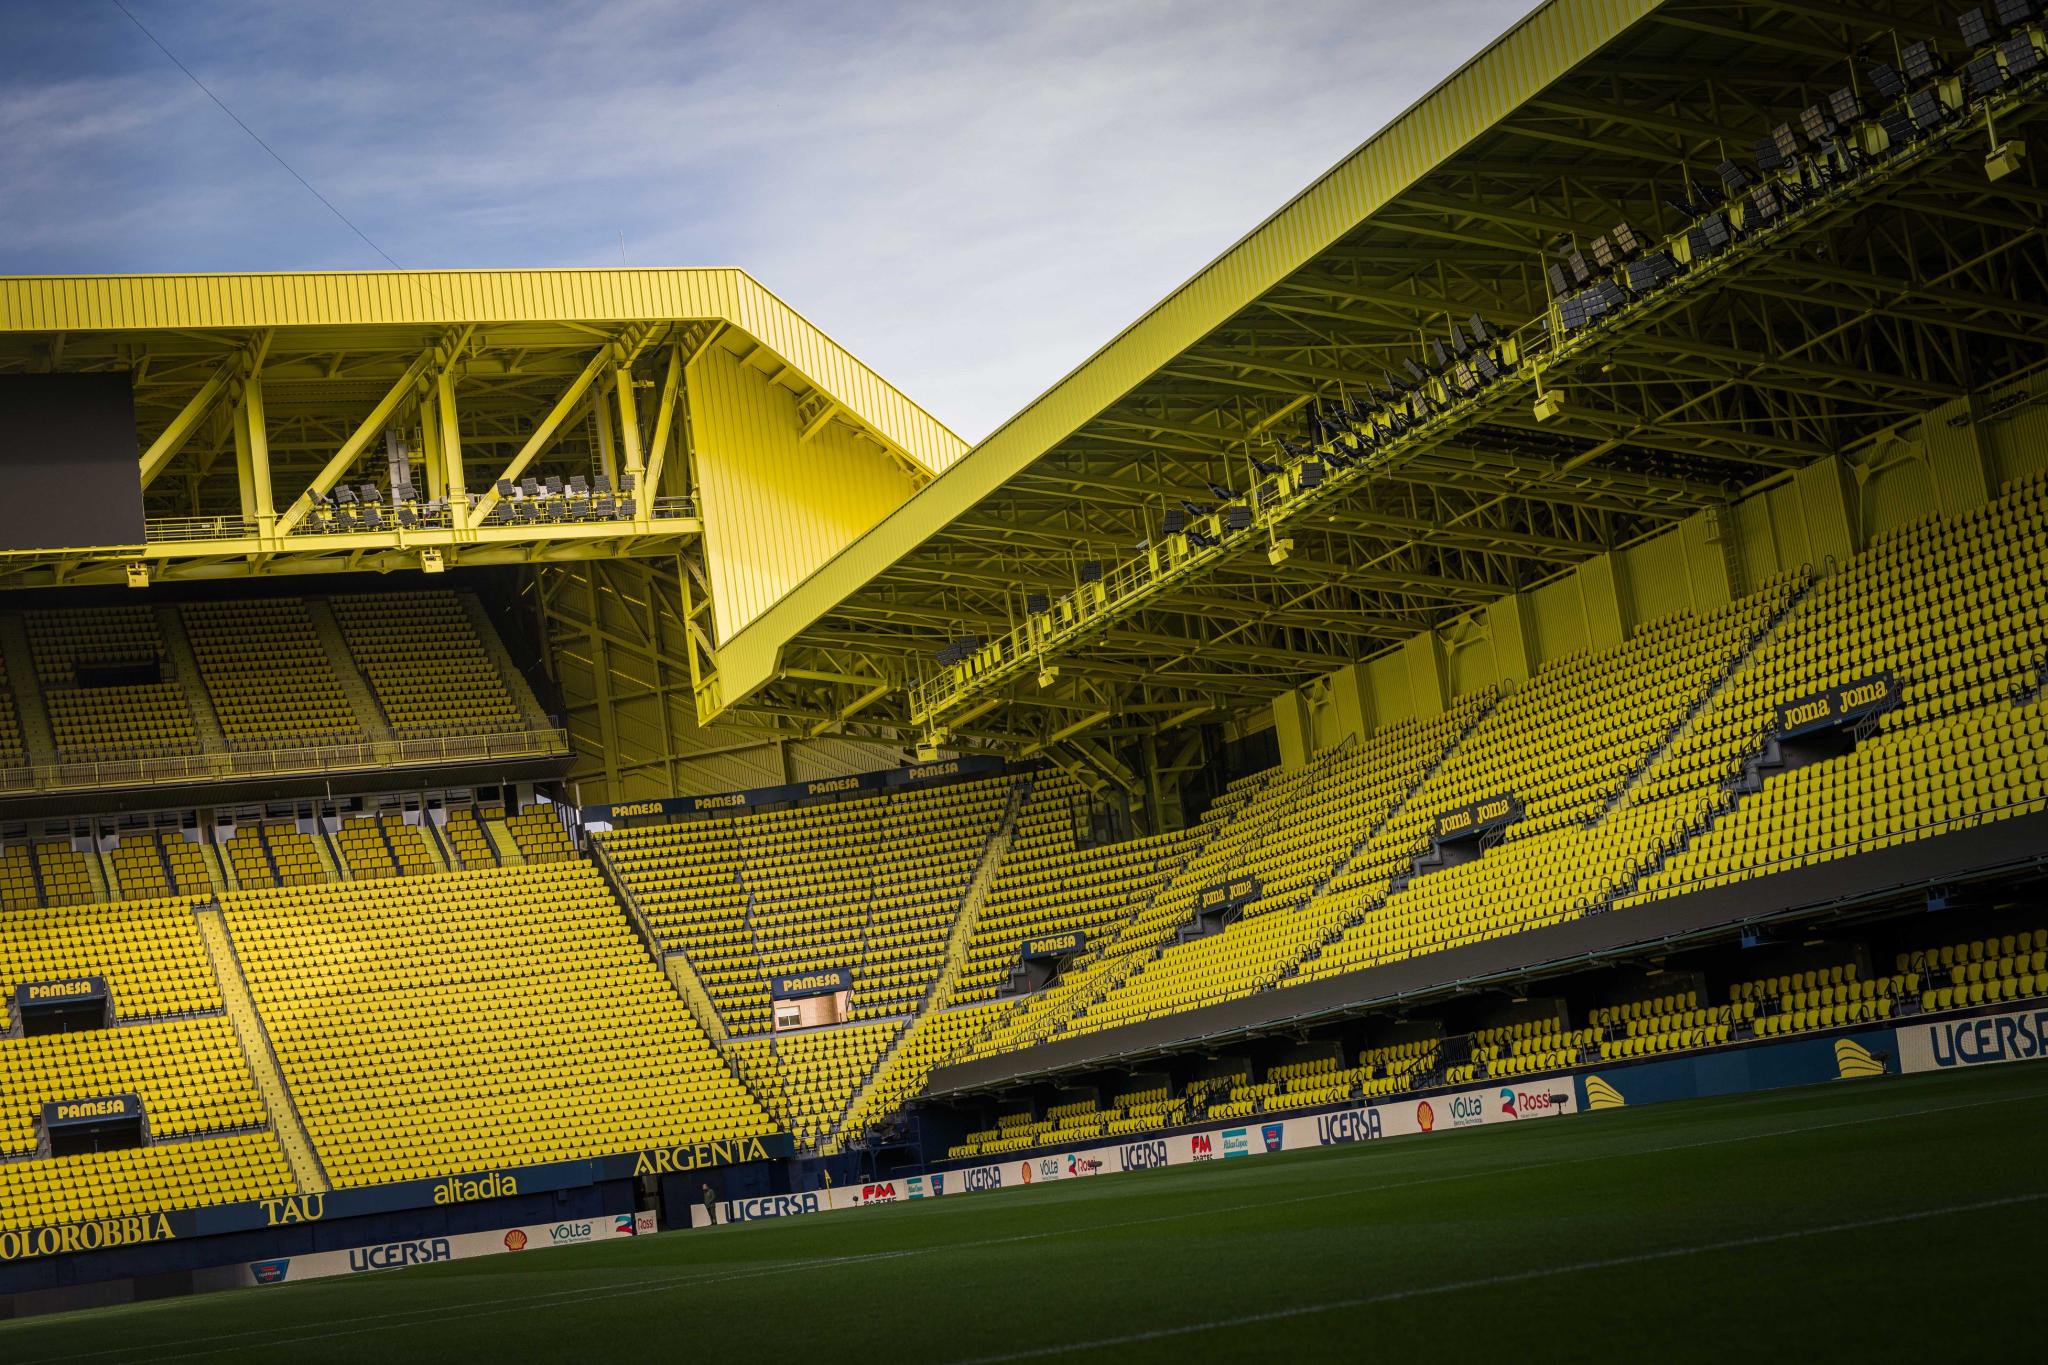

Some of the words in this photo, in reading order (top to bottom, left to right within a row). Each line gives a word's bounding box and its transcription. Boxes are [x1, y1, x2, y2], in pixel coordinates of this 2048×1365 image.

[908, 762, 960, 779] PAMESA
[807, 778, 860, 795] PAMESA
[611, 803, 663, 817] PAMESA
[694, 795, 746, 809] PAMESA
[1030, 935, 1076, 954] PAMESA
[29, 981, 92, 998] PAMESA
[783, 973, 840, 992] PAMESA
[57, 1100, 125, 1119] PAMESA
[1317, 1108, 1383, 1145] UCERSA
[1191, 1134, 1212, 1153] FM
[633, 1137, 769, 1176] ARGENTA
[1119, 1141, 1168, 1171] UCERSA
[433, 1172, 518, 1205] altadia
[963, 1166, 1002, 1192] UCERSA
[863, 1183, 896, 1199] FM
[259, 1193, 326, 1226] TAU
[725, 1193, 819, 1223] UCERSA
[350, 1238, 451, 1272] UCERSA
